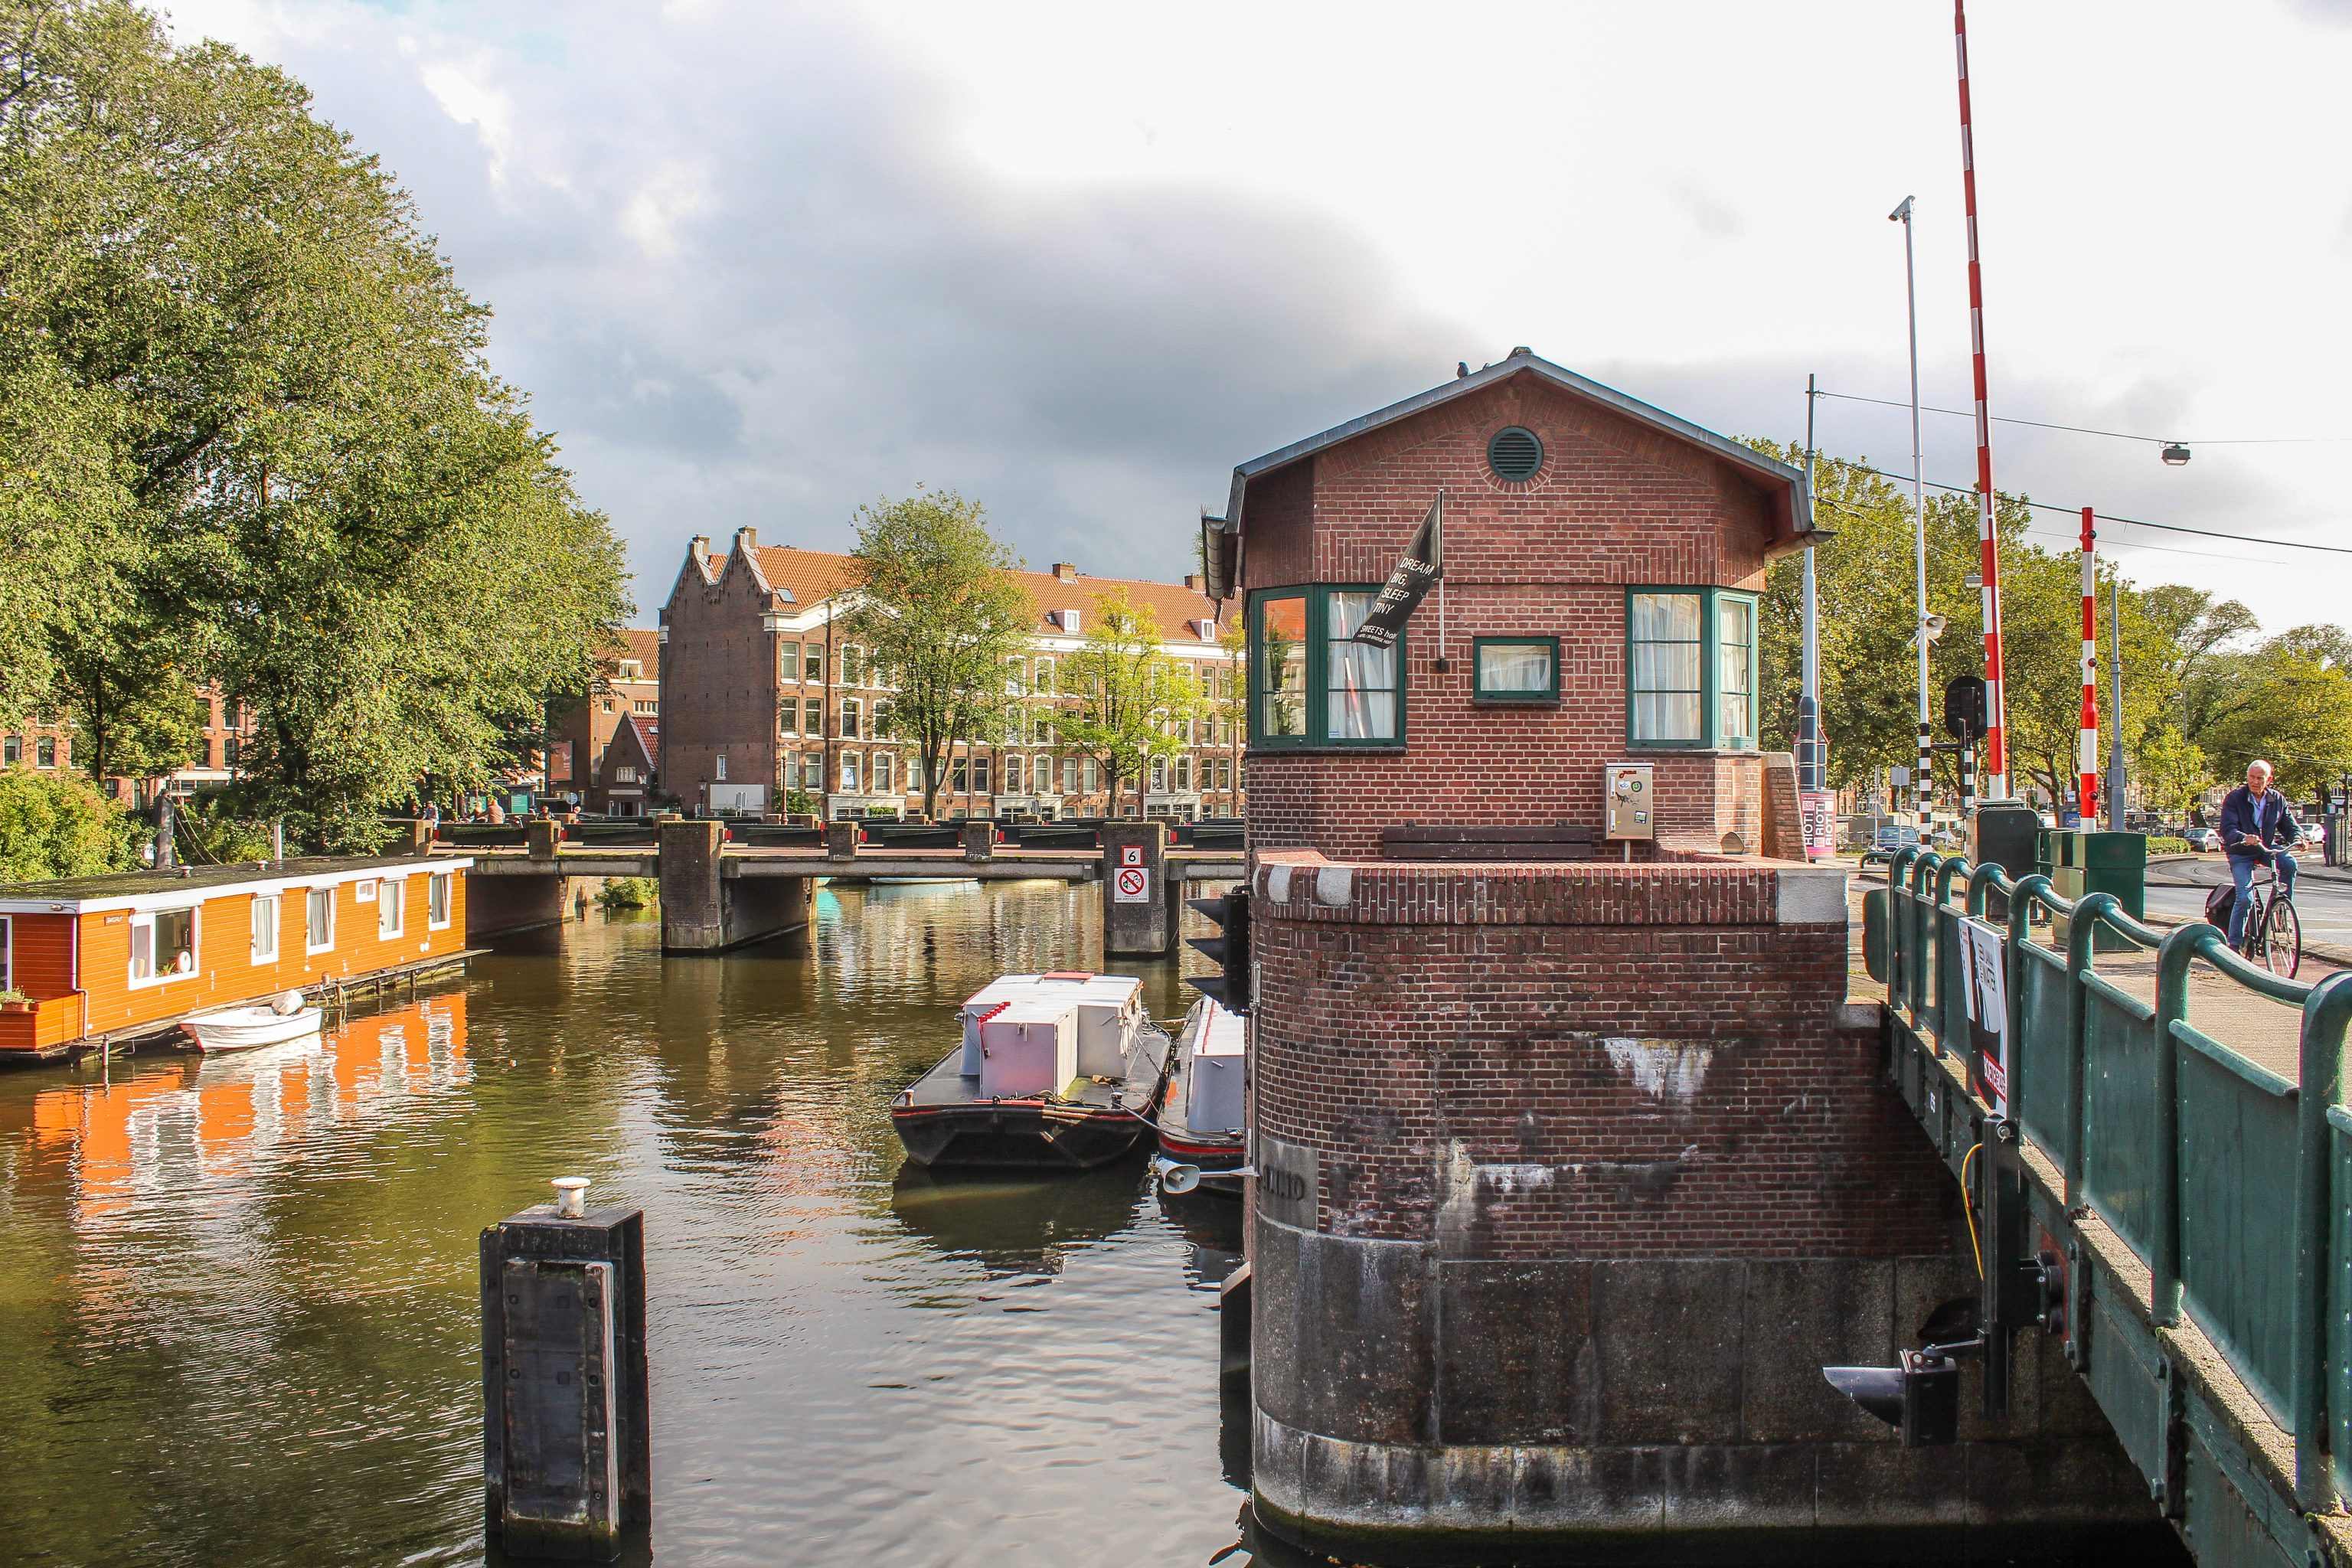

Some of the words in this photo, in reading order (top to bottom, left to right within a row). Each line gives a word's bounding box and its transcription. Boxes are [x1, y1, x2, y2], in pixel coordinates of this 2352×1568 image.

[1400, 557, 1435, 576] DREAM
[1390, 572, 1407, 586] BIG,
[1381, 587, 1410, 602] SLEEP
[1373, 602, 1395, 615] TINY
[1361, 625, 1384, 635] SWEETS
[1815, 803, 1824, 835] RIOT!
[1803, 813, 1814, 845] RIOT!
[1128, 851, 1136, 862] 6
